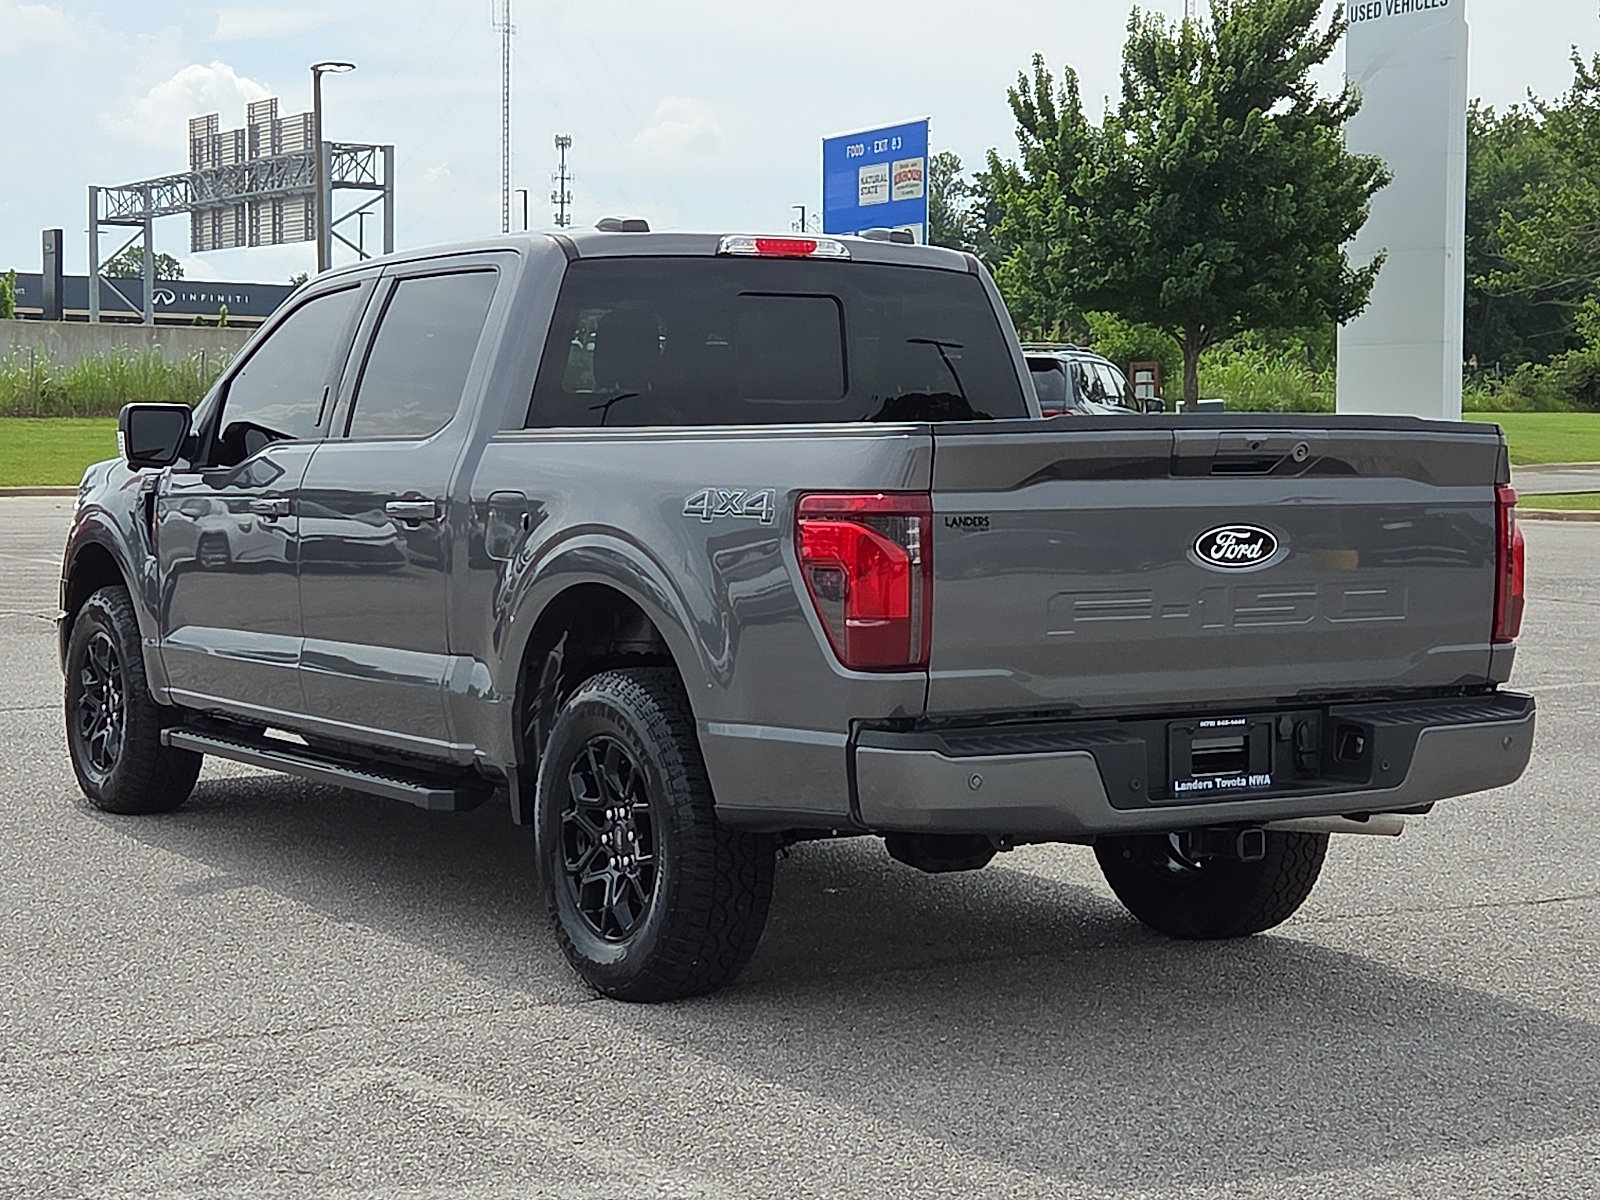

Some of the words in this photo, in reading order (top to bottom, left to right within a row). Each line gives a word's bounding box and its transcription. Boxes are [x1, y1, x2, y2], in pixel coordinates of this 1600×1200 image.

[1350, 1, 1382, 23] USED
[847, 144, 864, 158] FOOD
[874, 139, 888, 153] EXIT
[181, 292, 250, 304] INFINITI
[944, 515, 990, 528] LANDERS
[1210, 531, 1264, 560] Ford
[1046, 582, 1408, 636] F-150
[1174, 779, 1213, 792] Landers
[1215, 776, 1247, 789] Toyota
[1249, 773, 1271, 786] NWA
